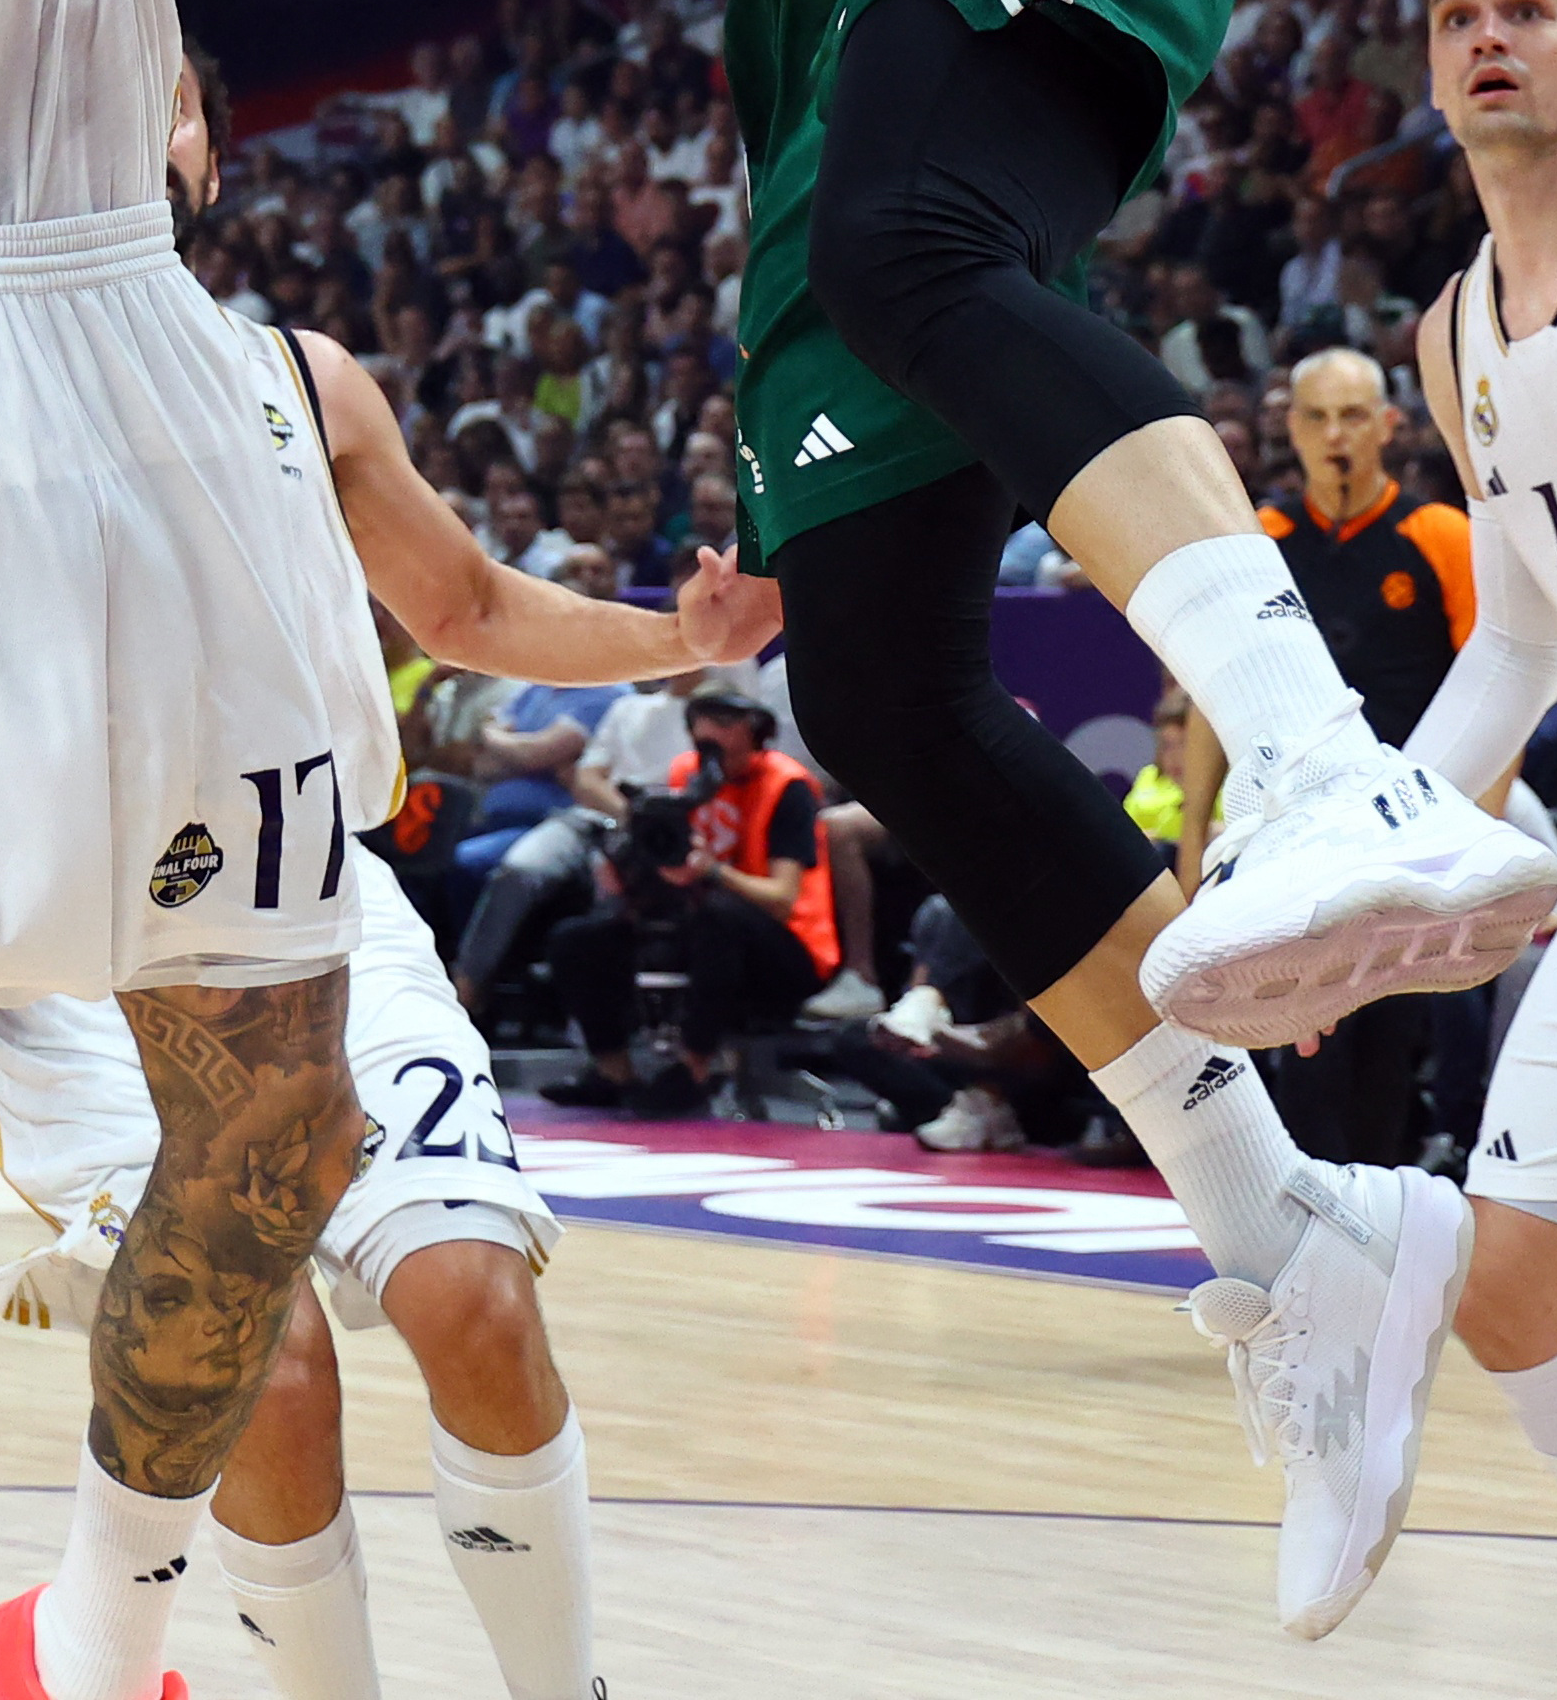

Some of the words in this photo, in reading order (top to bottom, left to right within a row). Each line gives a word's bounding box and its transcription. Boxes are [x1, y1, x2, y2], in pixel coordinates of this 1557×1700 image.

[240, 748, 345, 909] 17
[154, 860, 181, 878] INAL
[182, 854, 219, 873] FOUR
[1183, 1062, 1246, 1111] adidas
